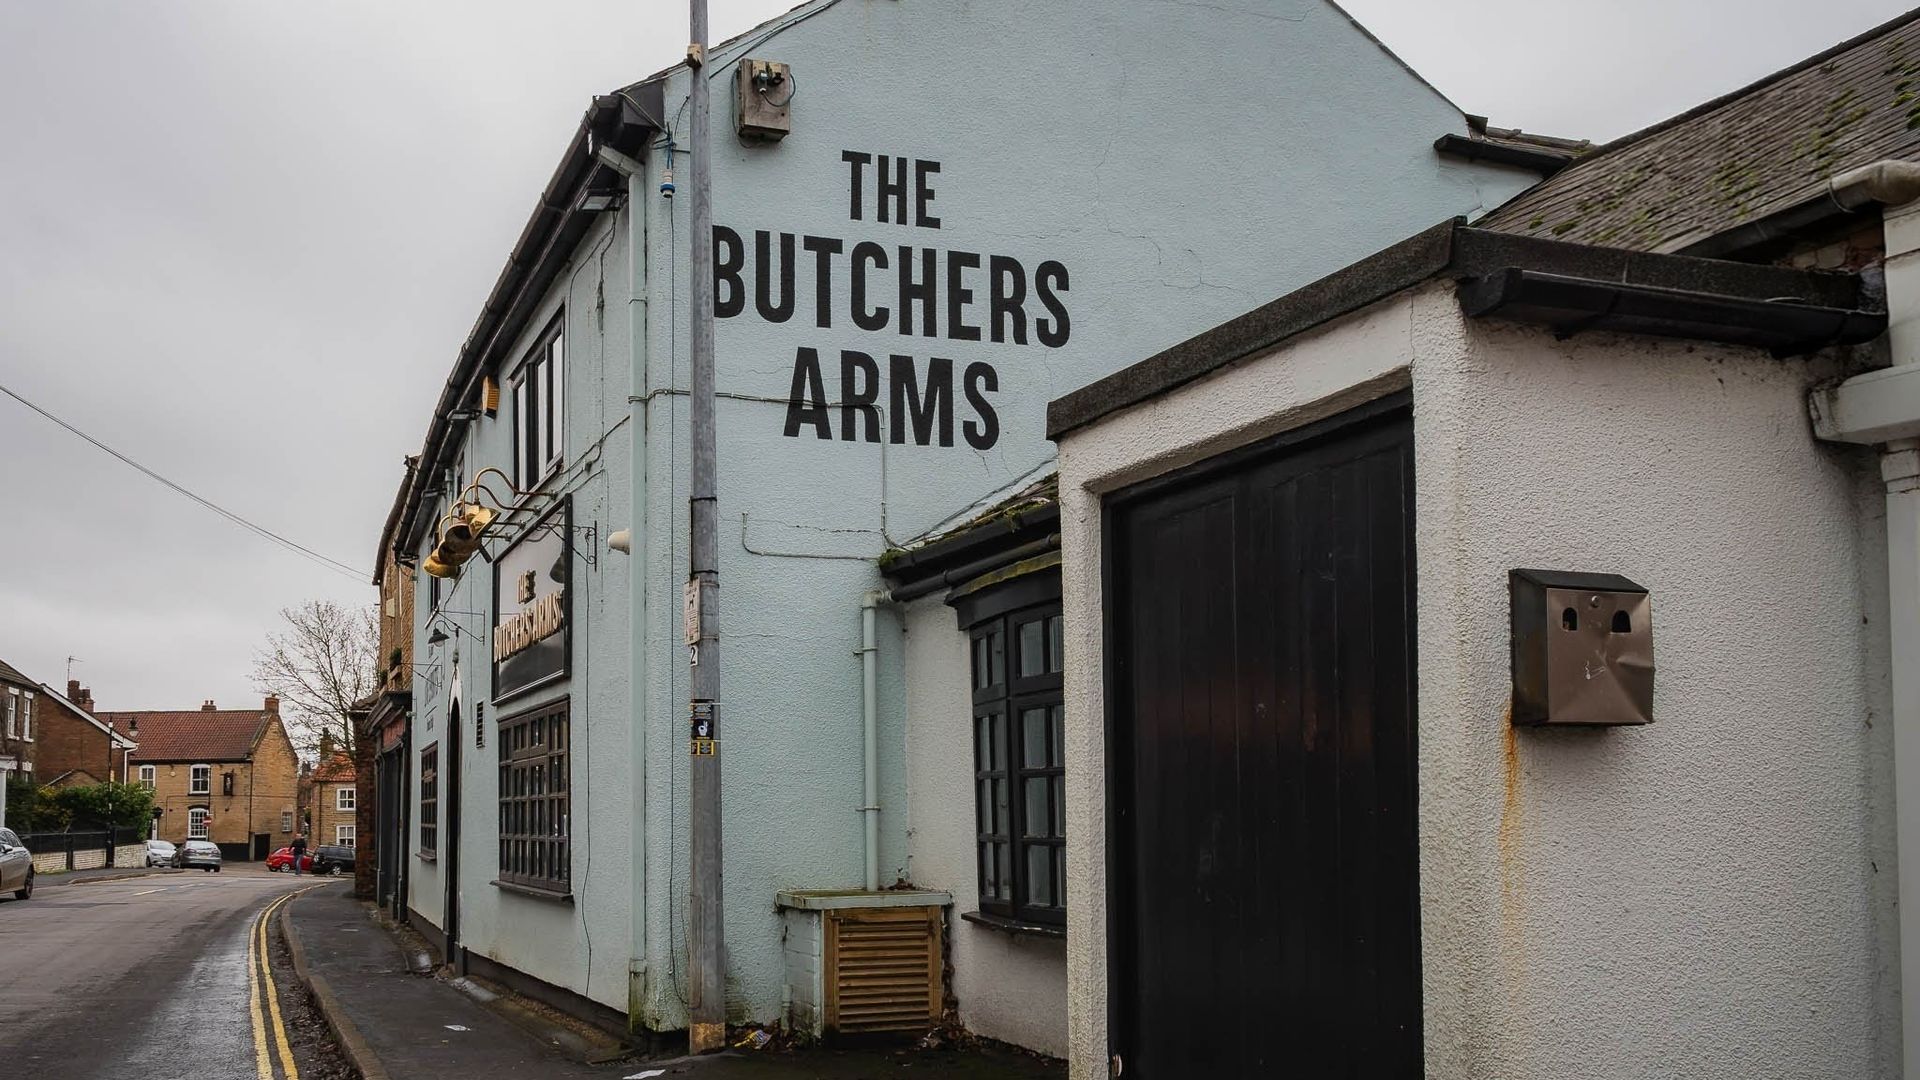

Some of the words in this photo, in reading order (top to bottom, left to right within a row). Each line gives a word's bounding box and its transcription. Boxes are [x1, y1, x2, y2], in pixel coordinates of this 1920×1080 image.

[842, 150, 941, 230] THE
[712, 224, 1071, 349] BUTCHERS
[783, 346, 1000, 451] ARMS
